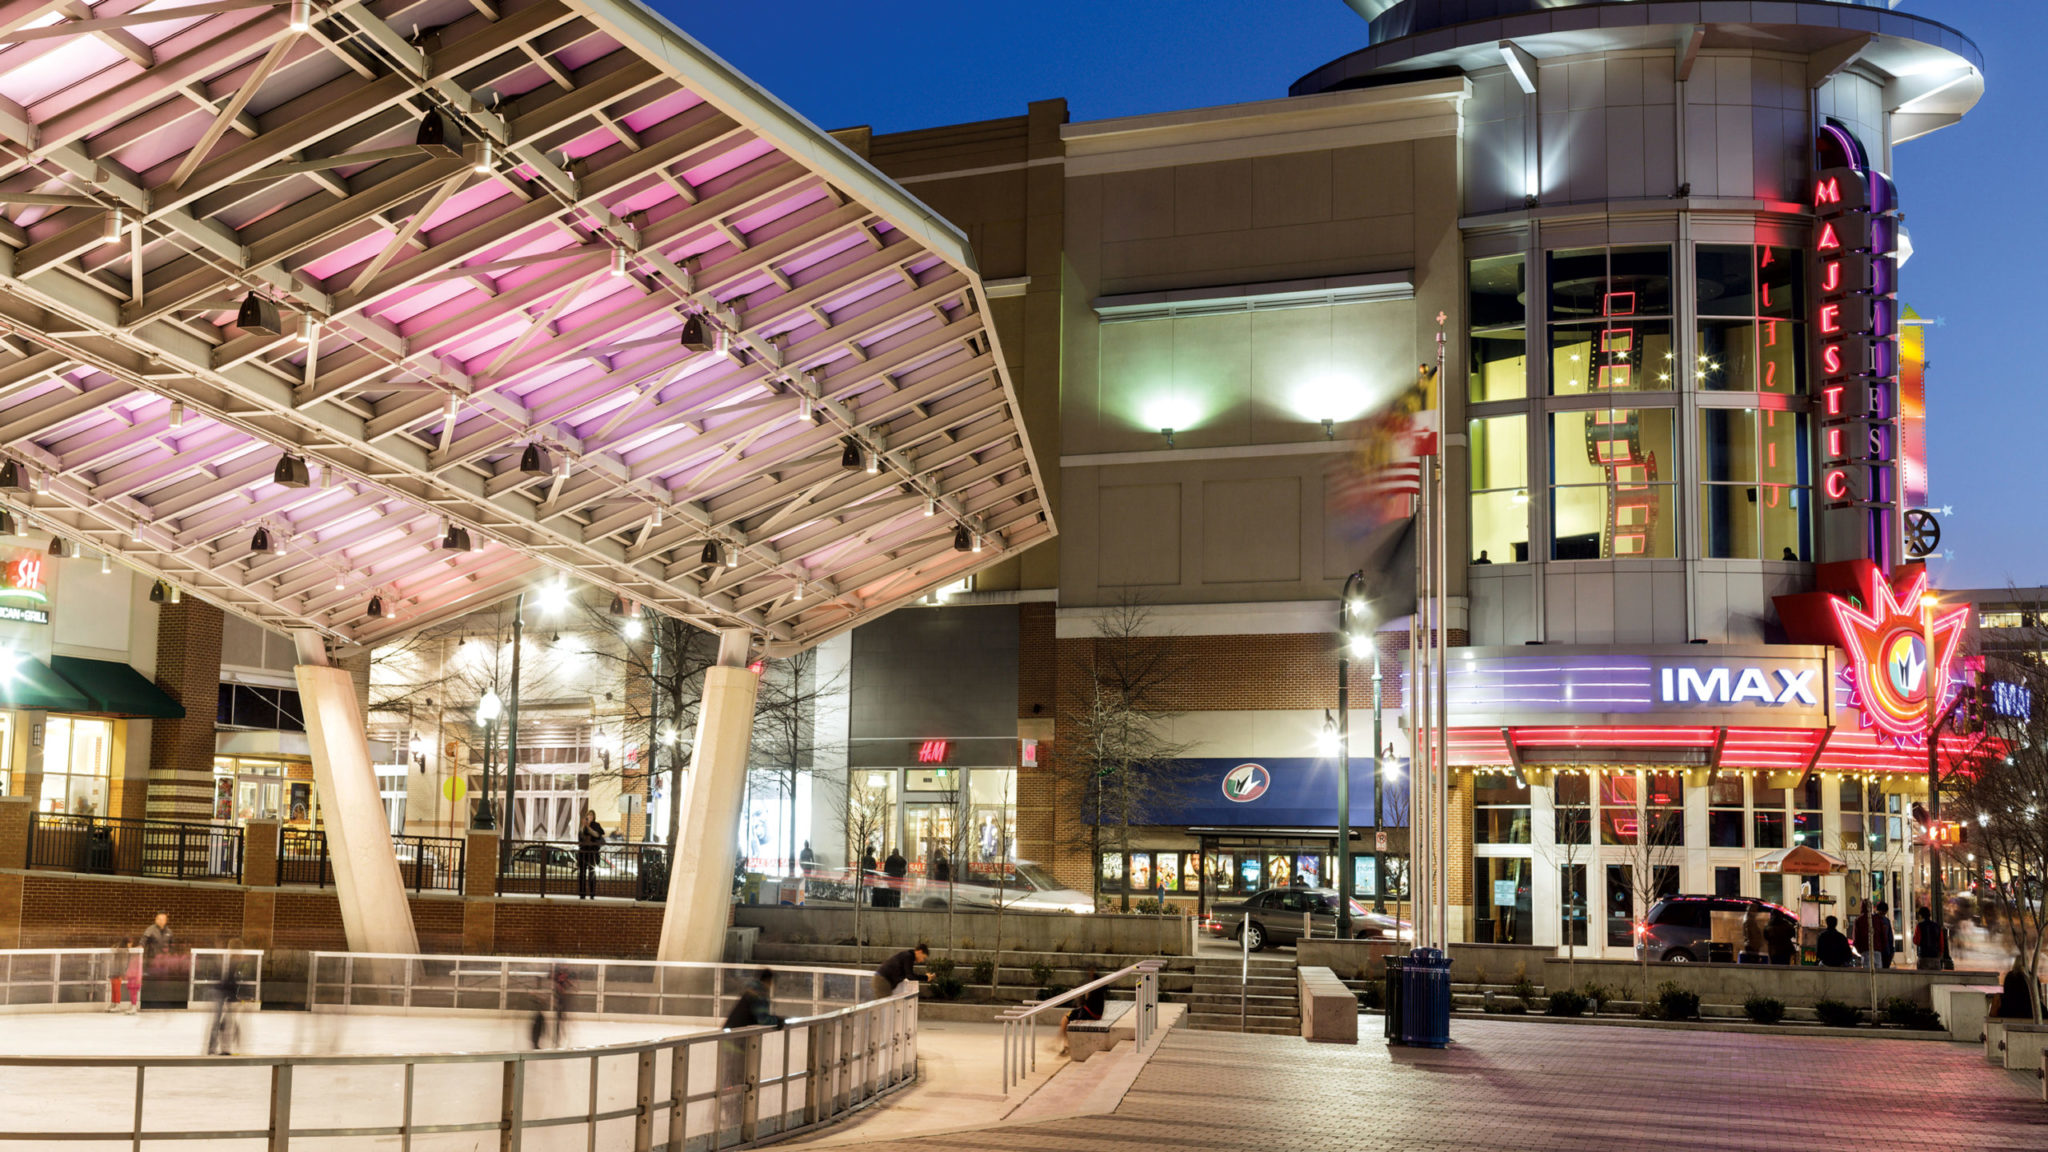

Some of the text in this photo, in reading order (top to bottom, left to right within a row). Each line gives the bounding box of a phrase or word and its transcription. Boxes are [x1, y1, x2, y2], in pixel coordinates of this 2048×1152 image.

[1815, 176, 1847, 499] MAJESTIC
[1661, 668, 1817, 704] IMAX
[909, 863, 926, 872] SALE
